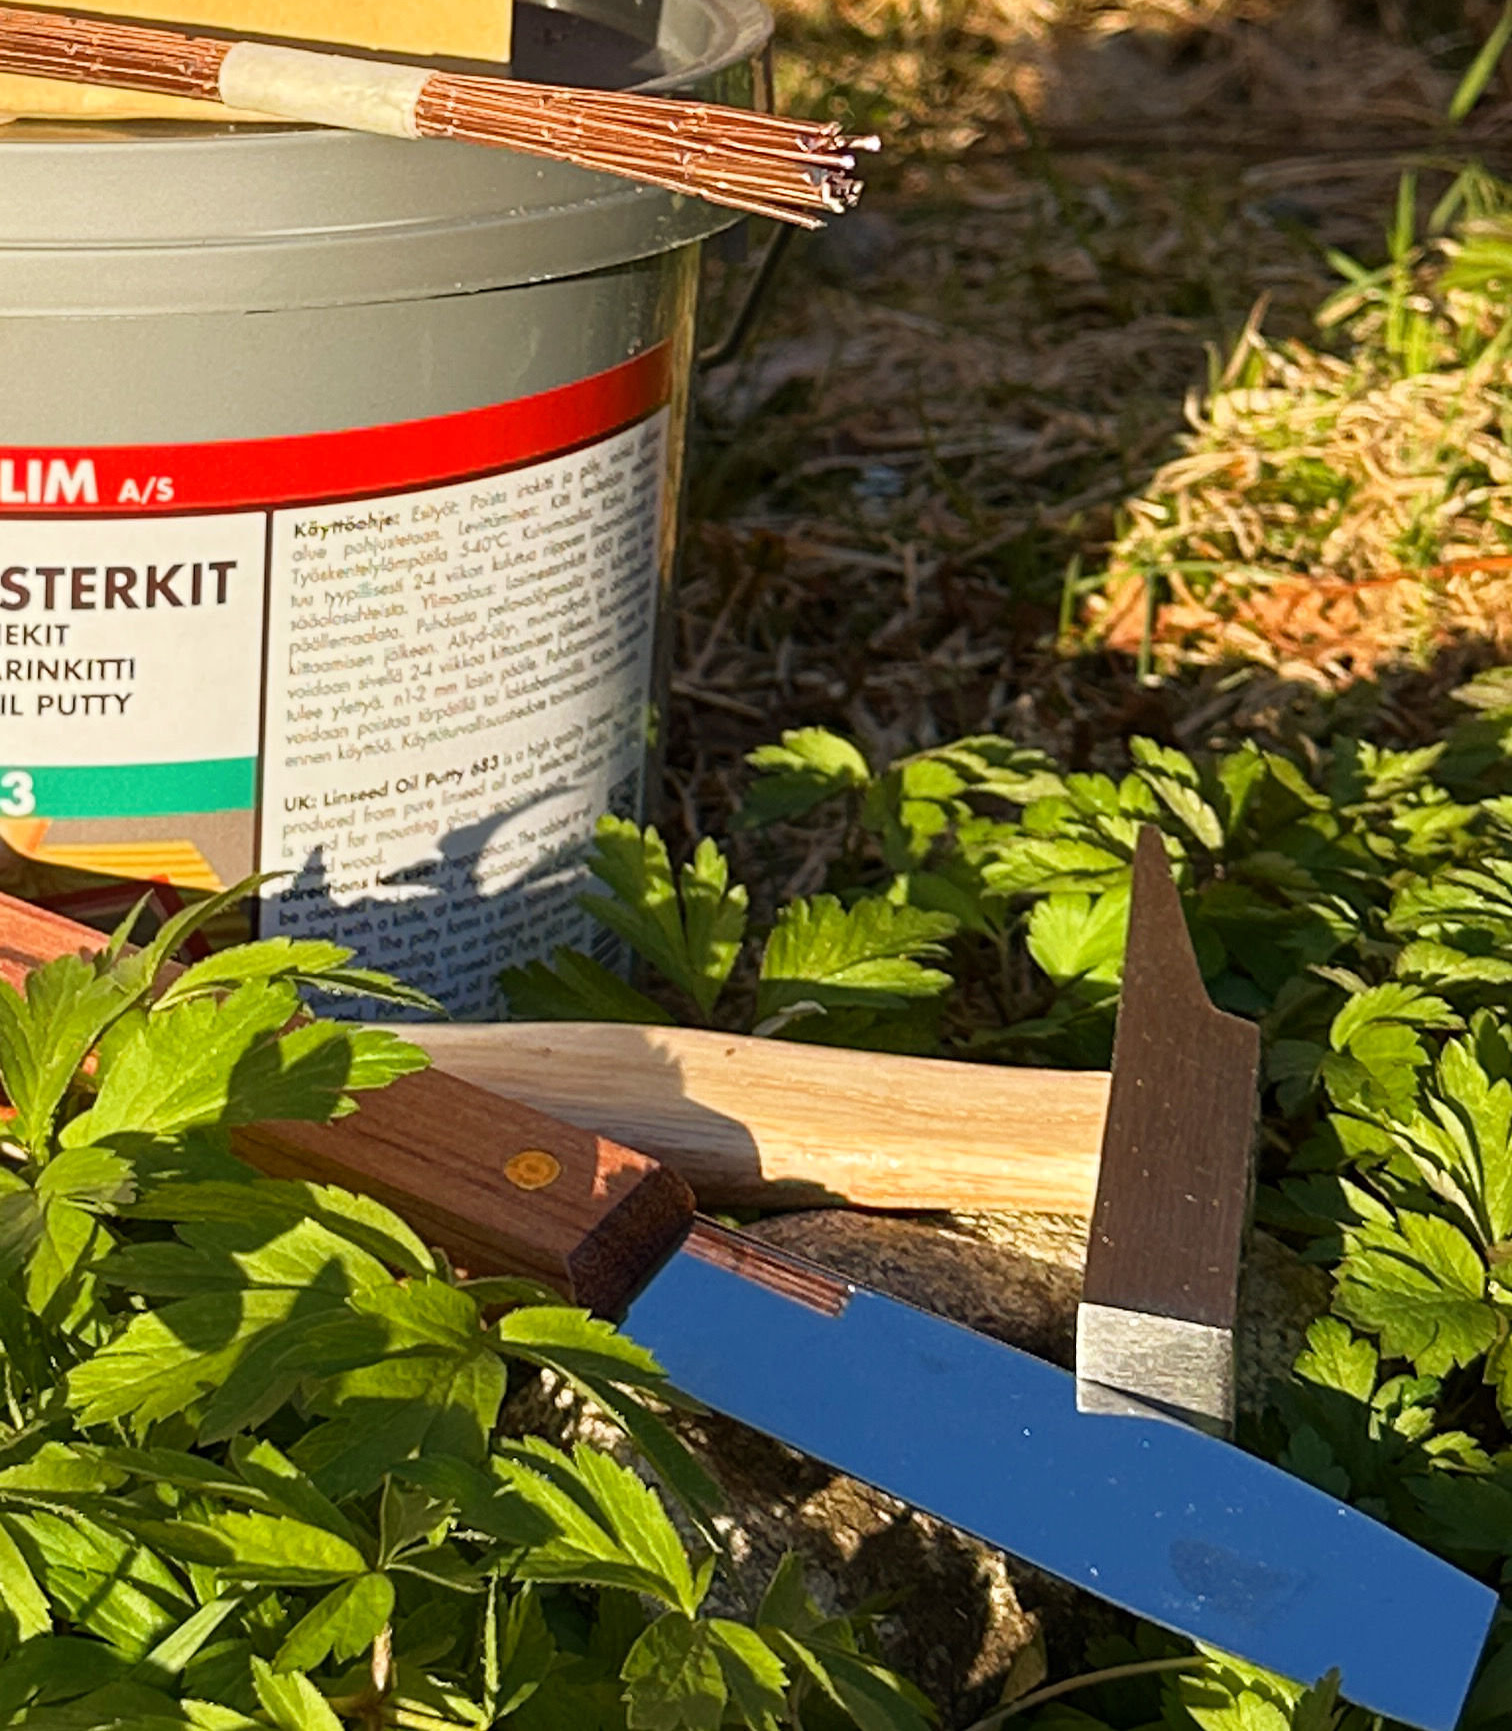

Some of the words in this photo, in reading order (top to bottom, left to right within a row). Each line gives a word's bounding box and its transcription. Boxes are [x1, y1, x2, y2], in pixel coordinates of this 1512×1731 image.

[117, 476, 174, 504] A/S
[37, 693, 133, 716] PUTTY
[285, 795, 317, 812] UK:
[324, 779, 389, 807] Linseed
[396, 774, 419, 793] Oil
